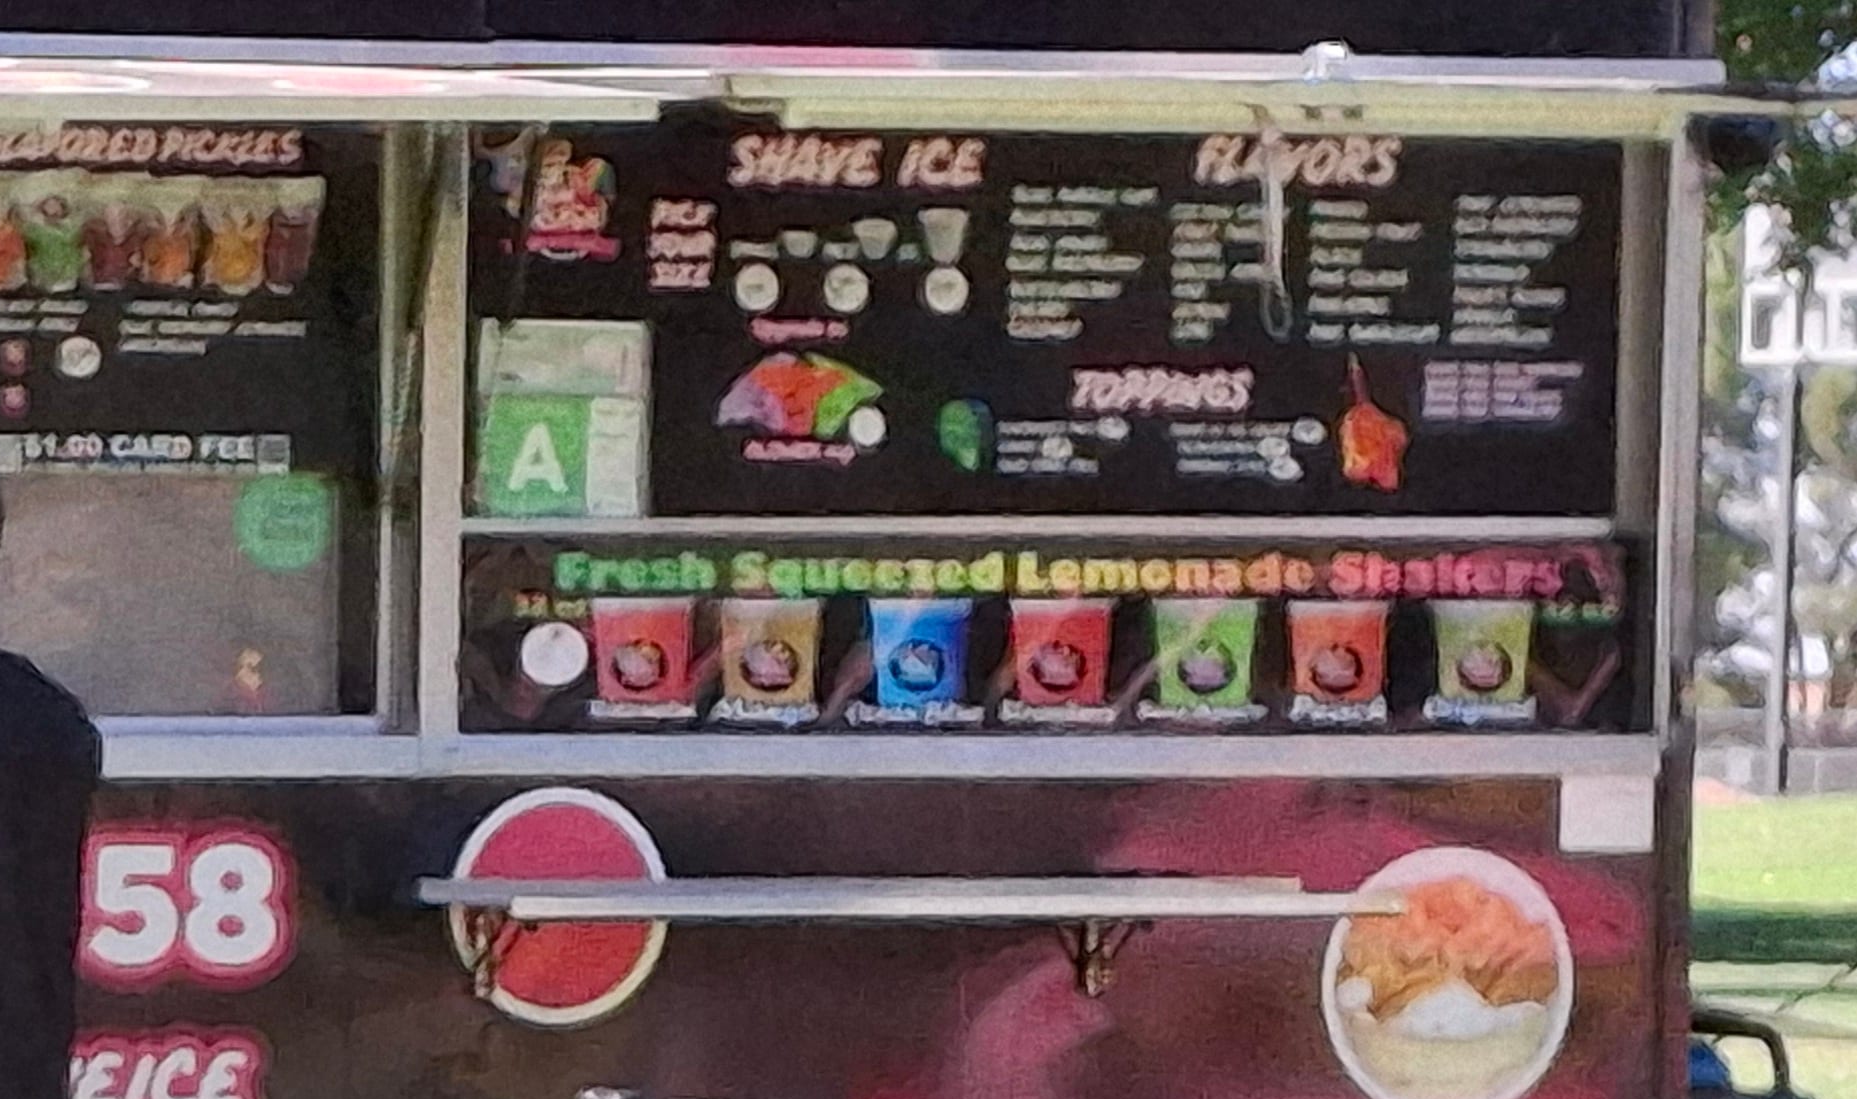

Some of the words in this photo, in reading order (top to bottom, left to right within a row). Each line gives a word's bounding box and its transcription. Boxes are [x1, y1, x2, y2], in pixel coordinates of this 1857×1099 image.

[898, 136, 986, 187] ICE
[508, 422, 569, 493] A
[555, 551, 716, 592] Fresh
[1017, 551, 1315, 594] Lemonade
